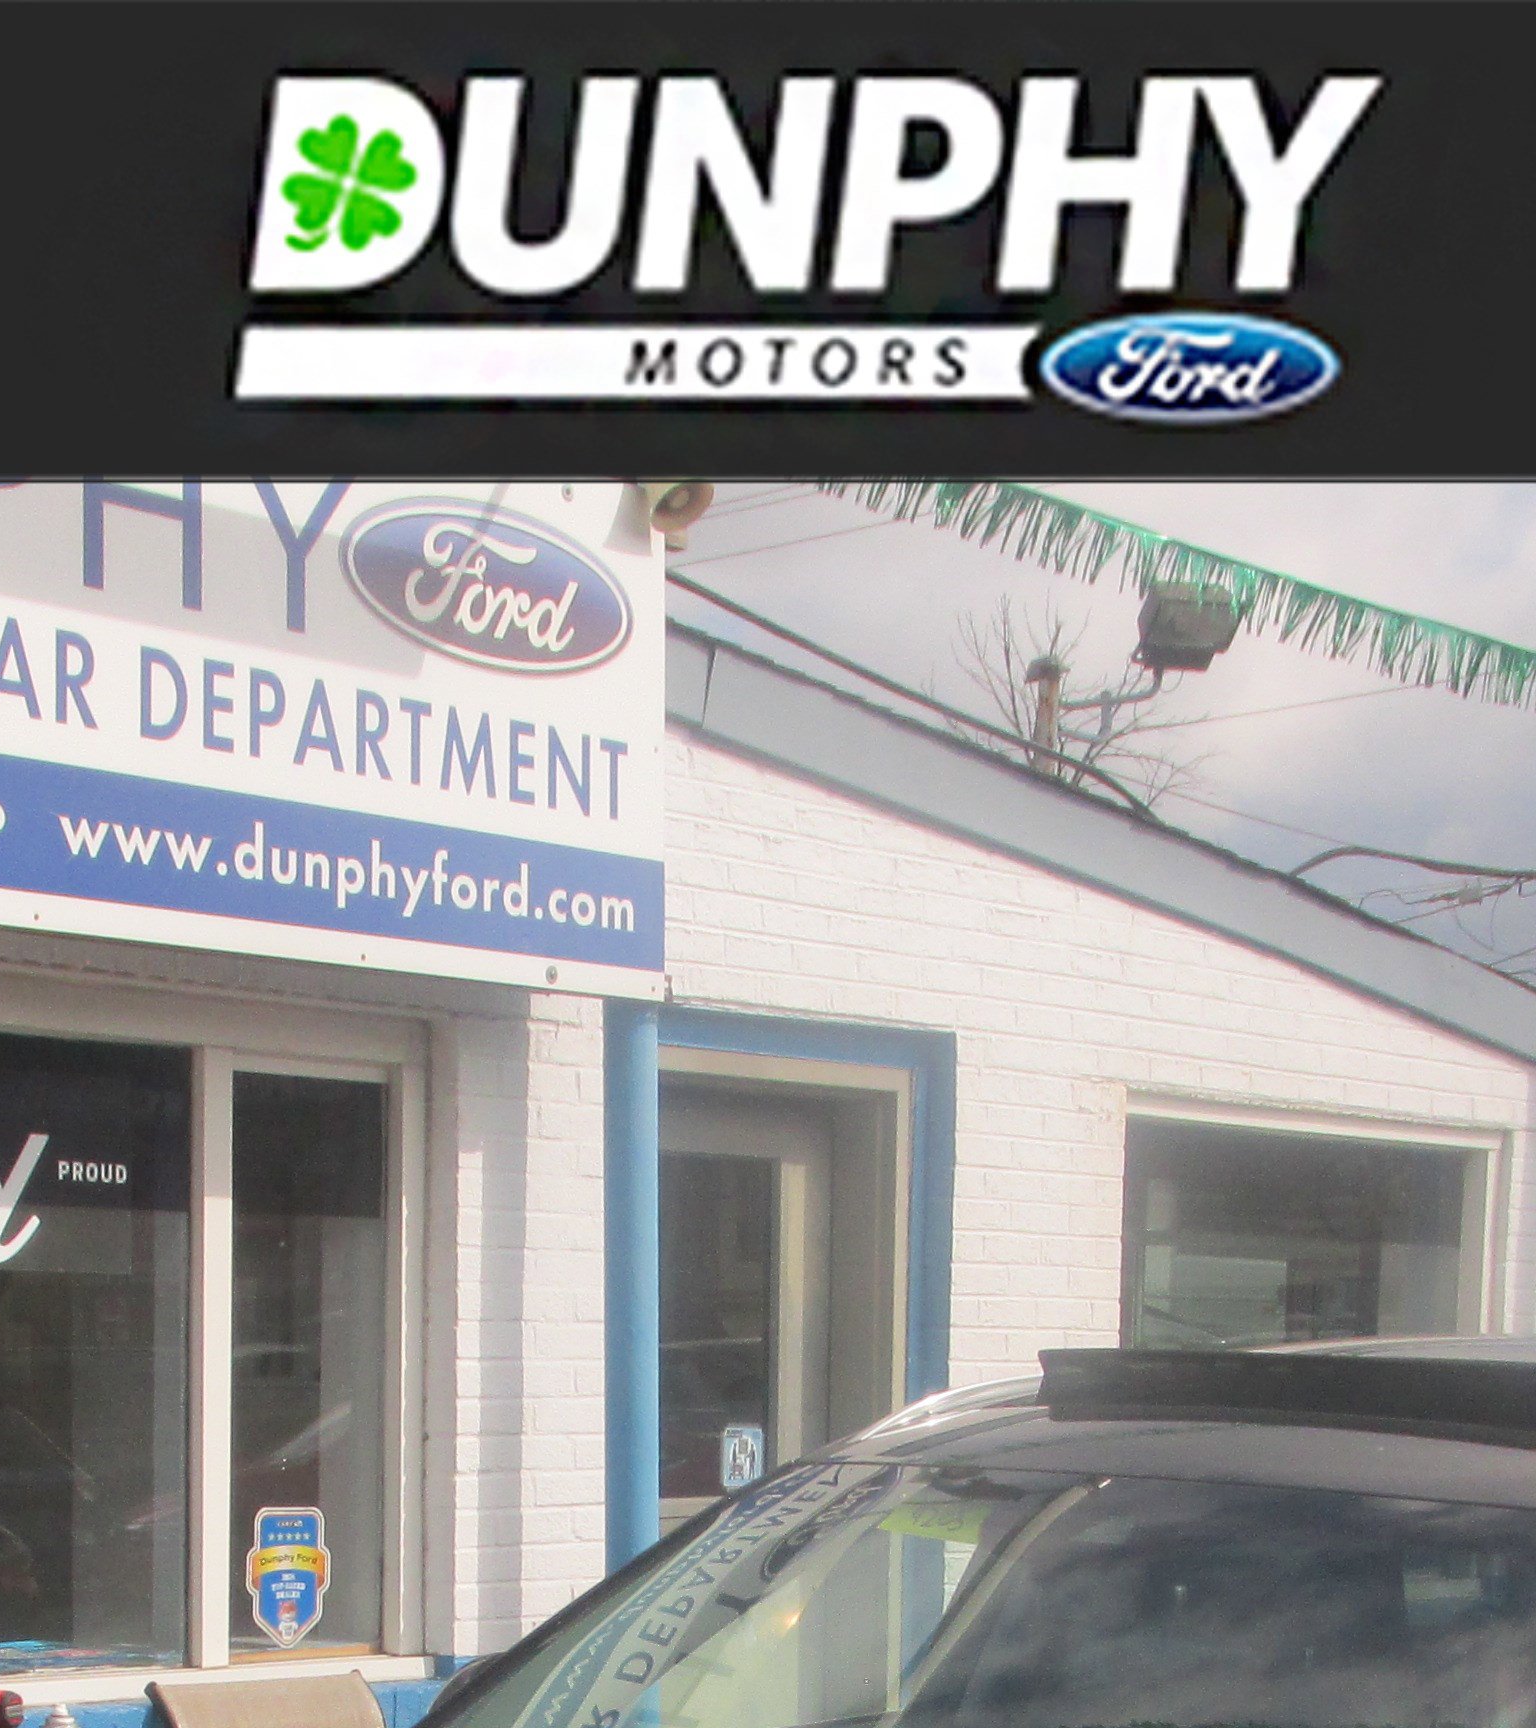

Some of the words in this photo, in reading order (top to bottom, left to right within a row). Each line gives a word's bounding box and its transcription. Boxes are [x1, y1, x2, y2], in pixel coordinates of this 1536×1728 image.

[404, 522, 580, 652] Ford
[139, 645, 631, 821] DEPARTMENT
[58, 820, 636, 932] www.dunphyford.com
[58, 1160, 128, 1184] PROUD
[259, 1553, 295, 1567] Dunphy
[296, 1552, 319, 1565] Ford
